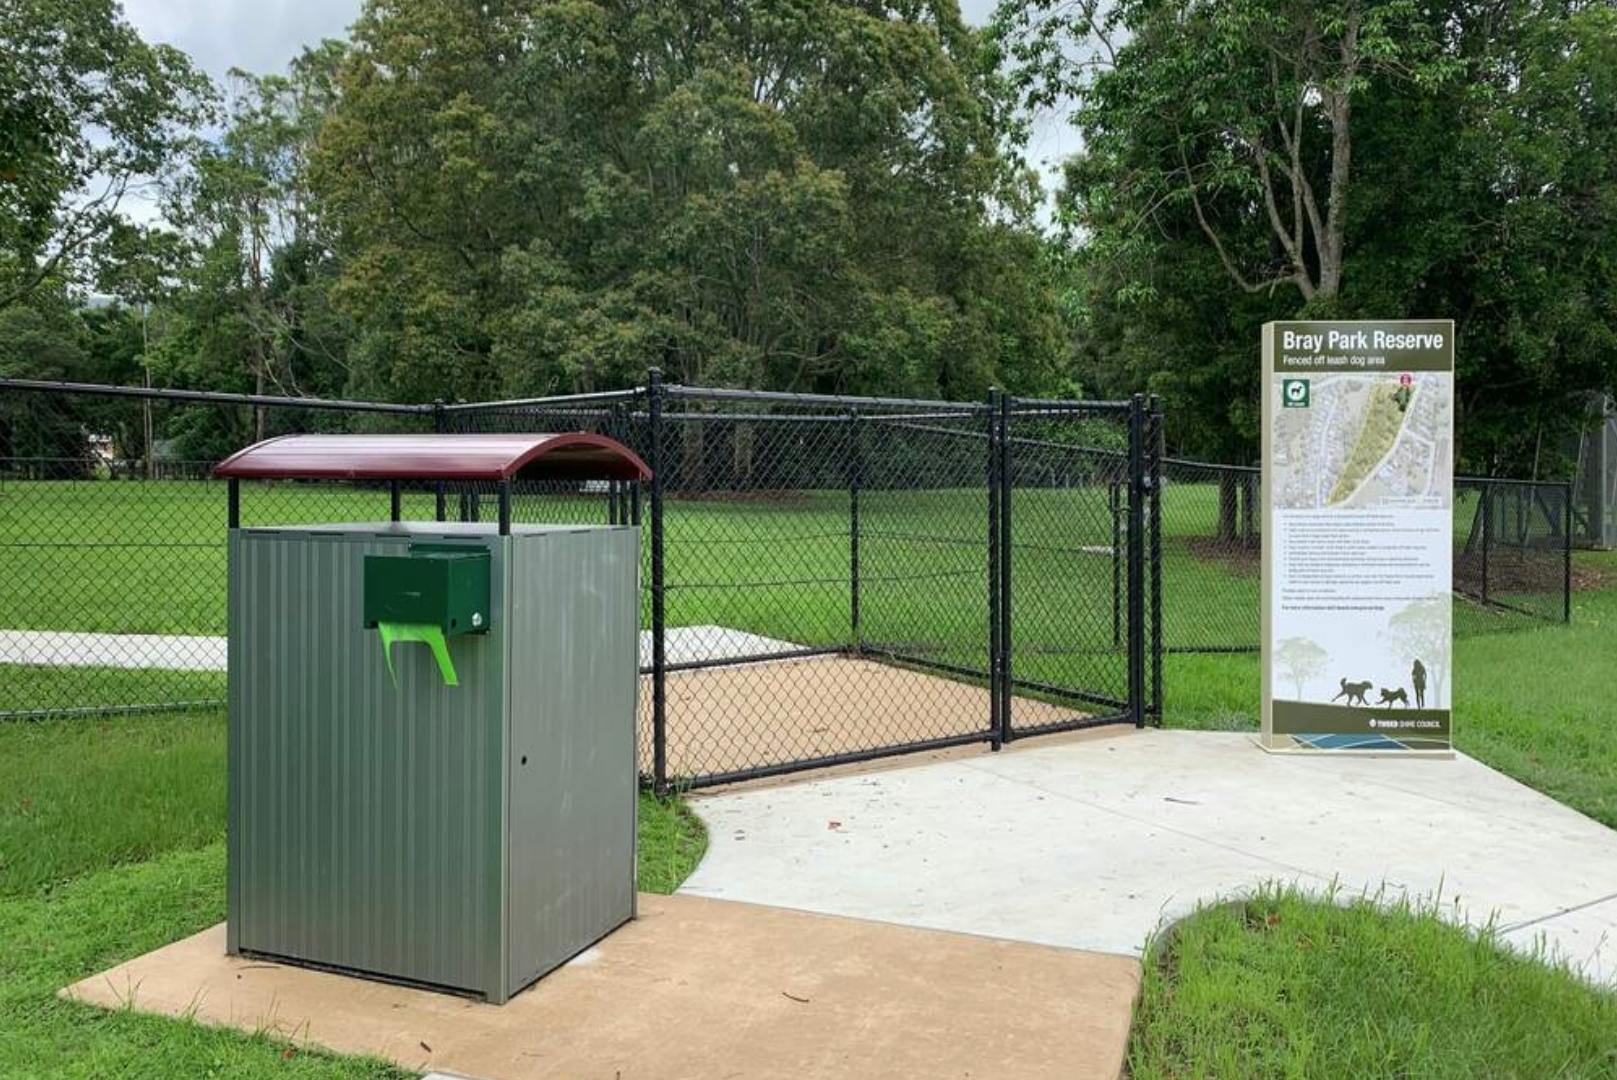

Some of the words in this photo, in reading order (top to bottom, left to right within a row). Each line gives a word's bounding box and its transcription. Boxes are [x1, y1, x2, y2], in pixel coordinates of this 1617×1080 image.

[1283, 330, 1324, 353] Bray
[1328, 330, 1368, 350] Park
[1373, 330, 1444, 350] Reserve
[1283, 355, 1312, 365] Fenced
[1350, 355, 1365, 367] dog
